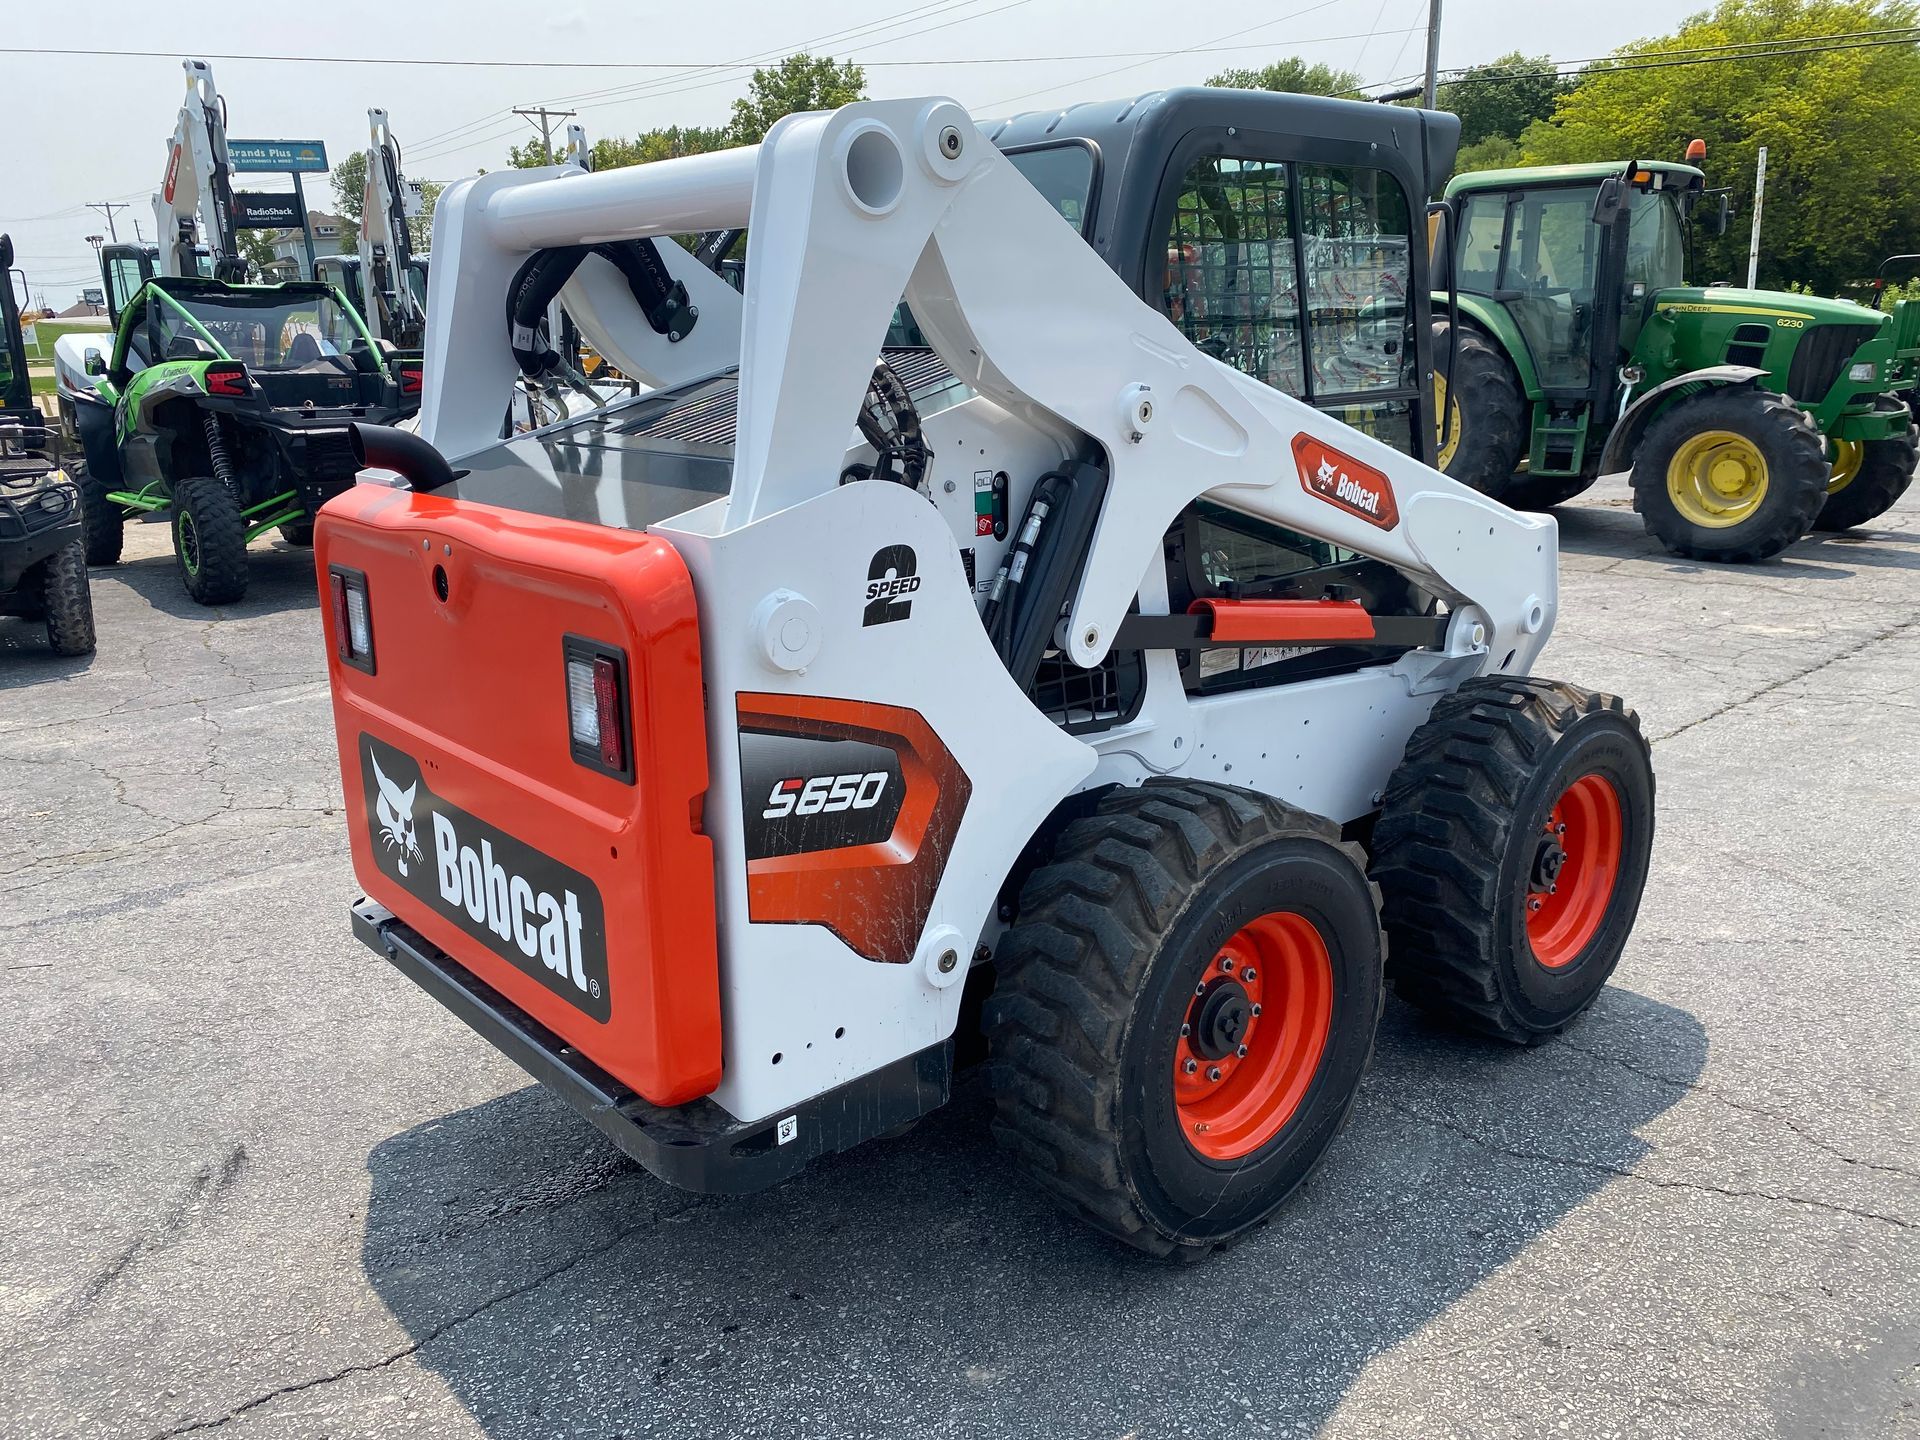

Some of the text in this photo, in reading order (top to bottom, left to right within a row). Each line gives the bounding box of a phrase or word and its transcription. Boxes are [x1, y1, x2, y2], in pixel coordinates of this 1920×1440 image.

[228, 148, 291, 157] Brands Plus
[246, 207, 292, 216] RadioShack
[1687, 304, 1712, 312] DEERE
[1776, 318, 1804, 329] 6230
[1336, 472, 1380, 515] Bobcat
[862, 544, 917, 627] 2
[866, 576, 921, 600] SPEED
[762, 771, 889, 819] S650
[432, 810, 587, 992] Bobcat
